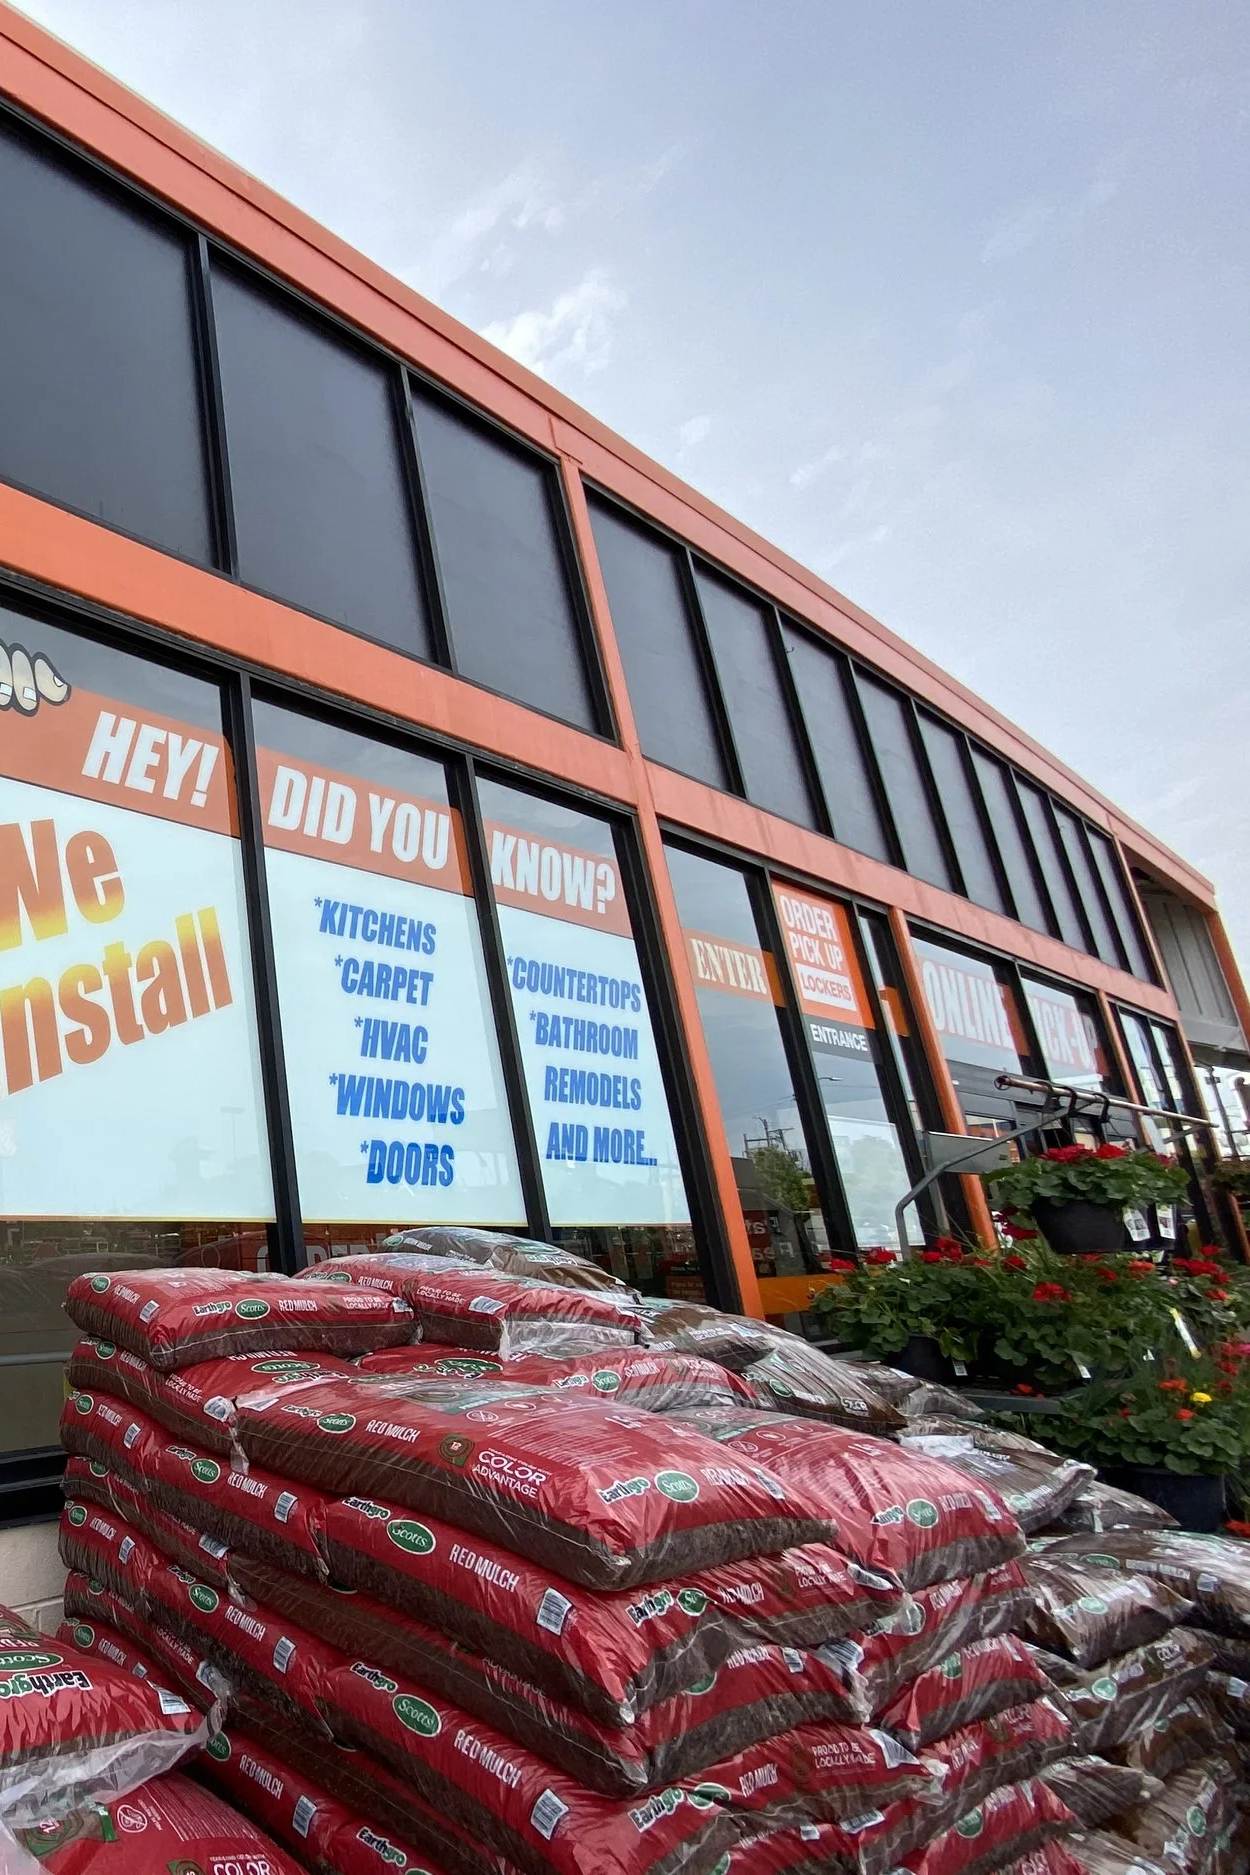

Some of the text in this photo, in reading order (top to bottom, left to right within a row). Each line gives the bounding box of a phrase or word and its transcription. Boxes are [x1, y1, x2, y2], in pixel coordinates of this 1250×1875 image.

[81, 710, 616, 914] HEY! DID YOU KNOW?
[779, 895, 838, 943] ORDER
[690, 938, 767, 995] ENTER
[788, 932, 843, 972] PICK UP
[801, 971, 852, 1001] LOCKERS
[810, 1023, 868, 1052] ENTRANCE
[544, 1065, 642, 1111] REMODELS
[546, 1122, 588, 1161] AND
[358, 1276, 393, 1290] RED MULCH
[194, 1301, 318, 1315] Earthgro Scotts RED MULCH
[365, 1420, 385, 1434] RED
[384, 1424, 421, 1443] MULCH
[227, 1471, 242, 1488] RED
[241, 1477, 268, 1499] MULCH
[472, 1464, 539, 1499] ADVANTAGE
[479, 1451, 547, 1487] COLOR
[599, 1477, 693, 1503] Earthgro Scotts
[343, 1496, 520, 1592] Earthgro Scotts RED MULCH
[225, 1605, 242, 1627] RED
[239, 1614, 266, 1642] MULCH
[351, 1661, 522, 1789] Earthgro Scotts RED MULCH
[240, 1755, 284, 1800] RED MULCH
[630, 1788, 684, 1832] Earthgro
[357, 1826, 407, 1867] Earthgro
